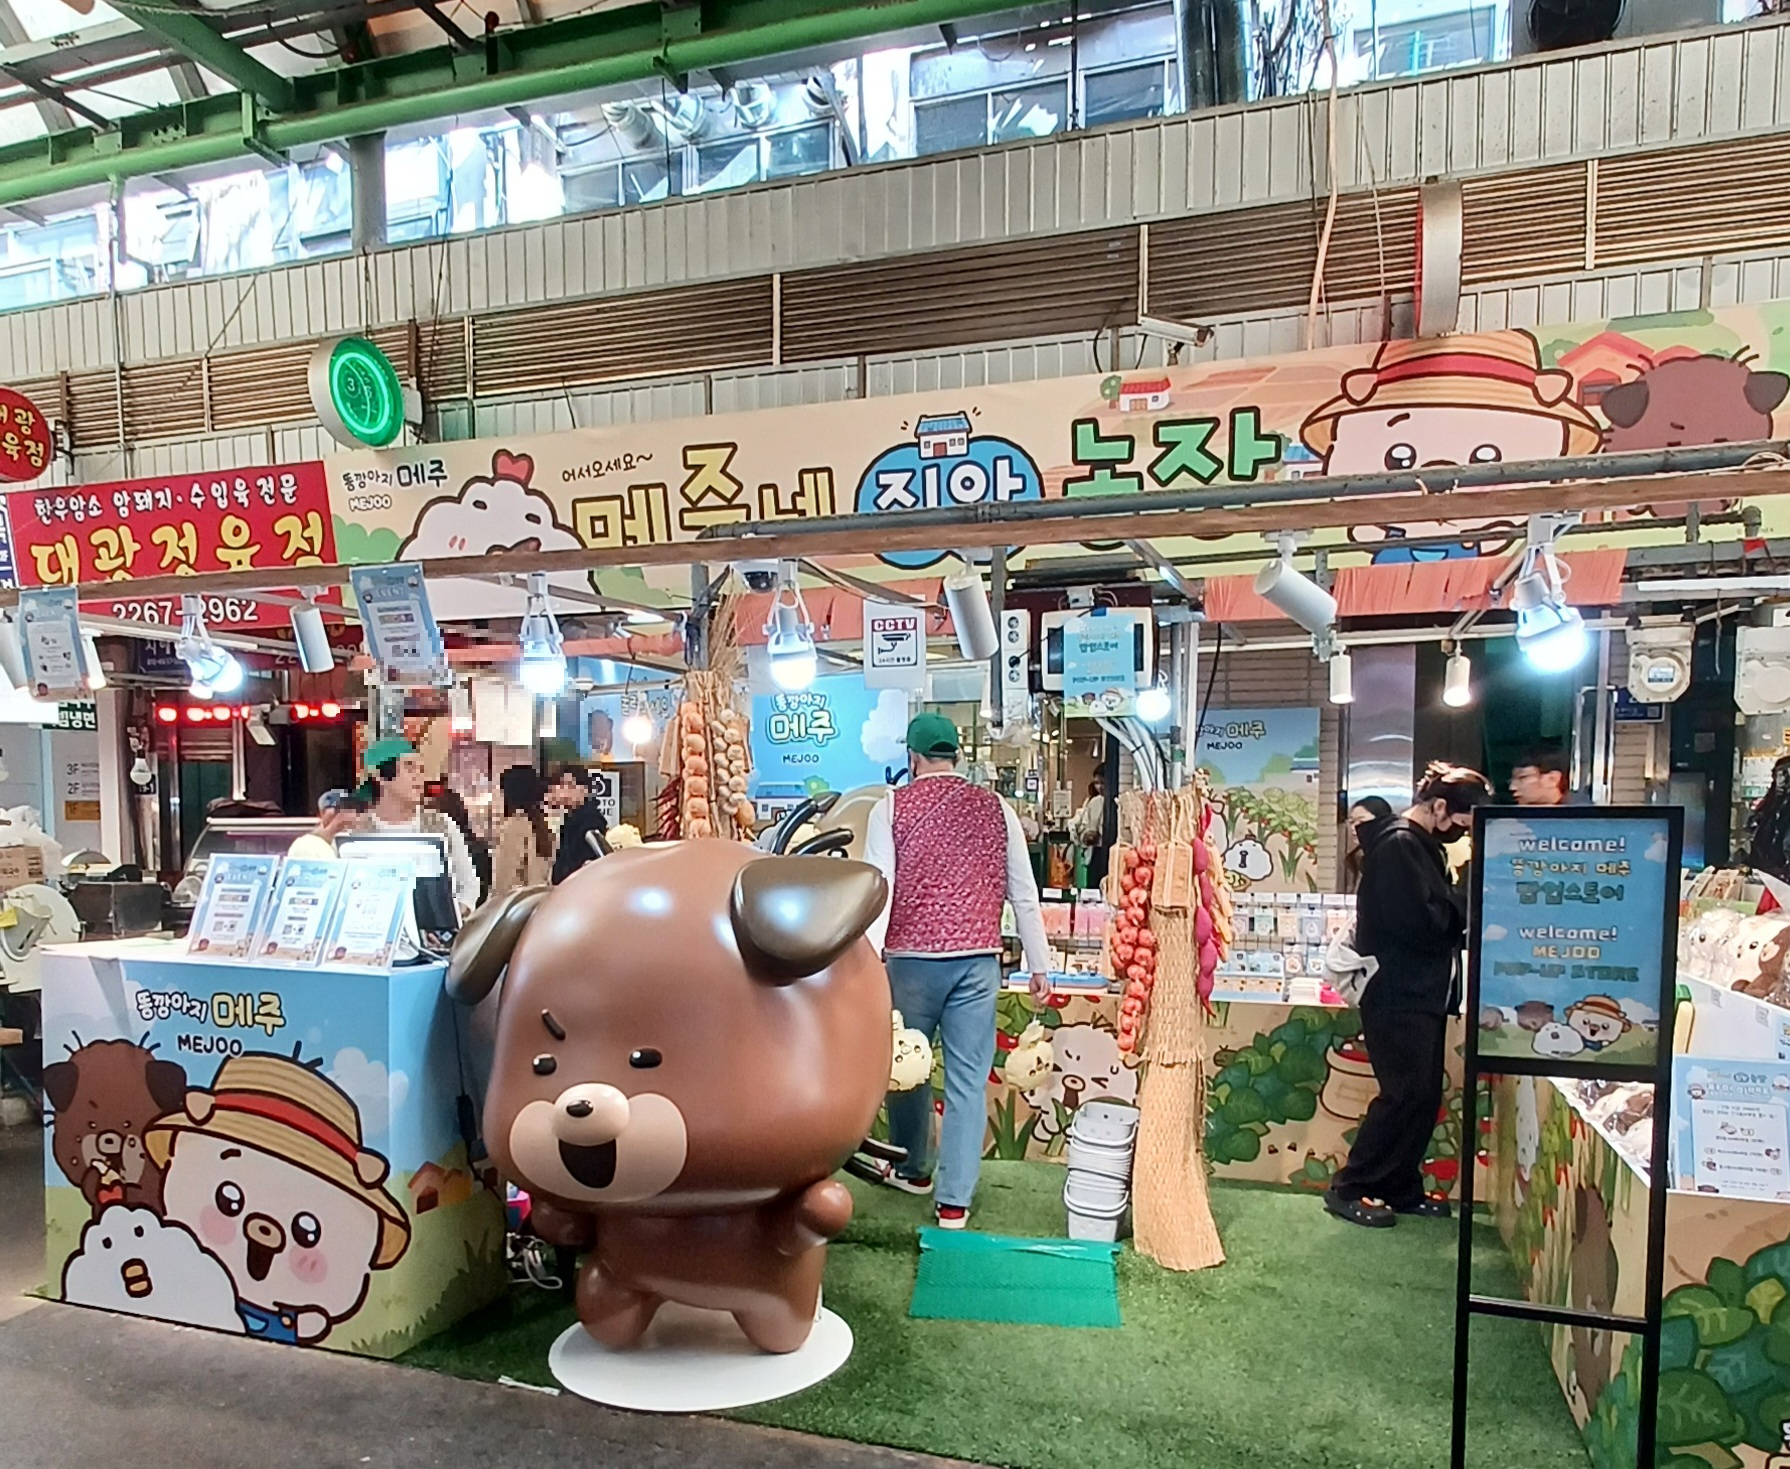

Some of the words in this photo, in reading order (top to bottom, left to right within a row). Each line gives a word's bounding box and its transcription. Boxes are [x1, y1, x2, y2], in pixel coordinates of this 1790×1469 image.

[396, 459, 448, 488] 메주
[562, 452, 653, 483] 어서오세요~
[349, 494, 392, 512] MEJOO
[874, 618, 915, 631] CCTV
[767, 711, 836, 744] 메주
[1226, 720, 1266, 739] 메주
[1206, 741, 1243, 750] MEJOO
[783, 754, 819, 764] MEJOO
[1519, 837, 1626, 853] welcome!
[1596, 859, 1631, 878] 메주
[1516, 881, 1624, 904] 팝업스토어
[1519, 925, 1618, 942] welcome!
[1532, 945, 1601, 960] MEJOO
[1494, 961, 1566, 978] POP-UP
[1571, 964, 1639, 983] STORE
[136, 989, 209, 1024] 똥깡아지
[211, 992, 287, 1037] 메주
[177, 1034, 243, 1056] MEJOO
